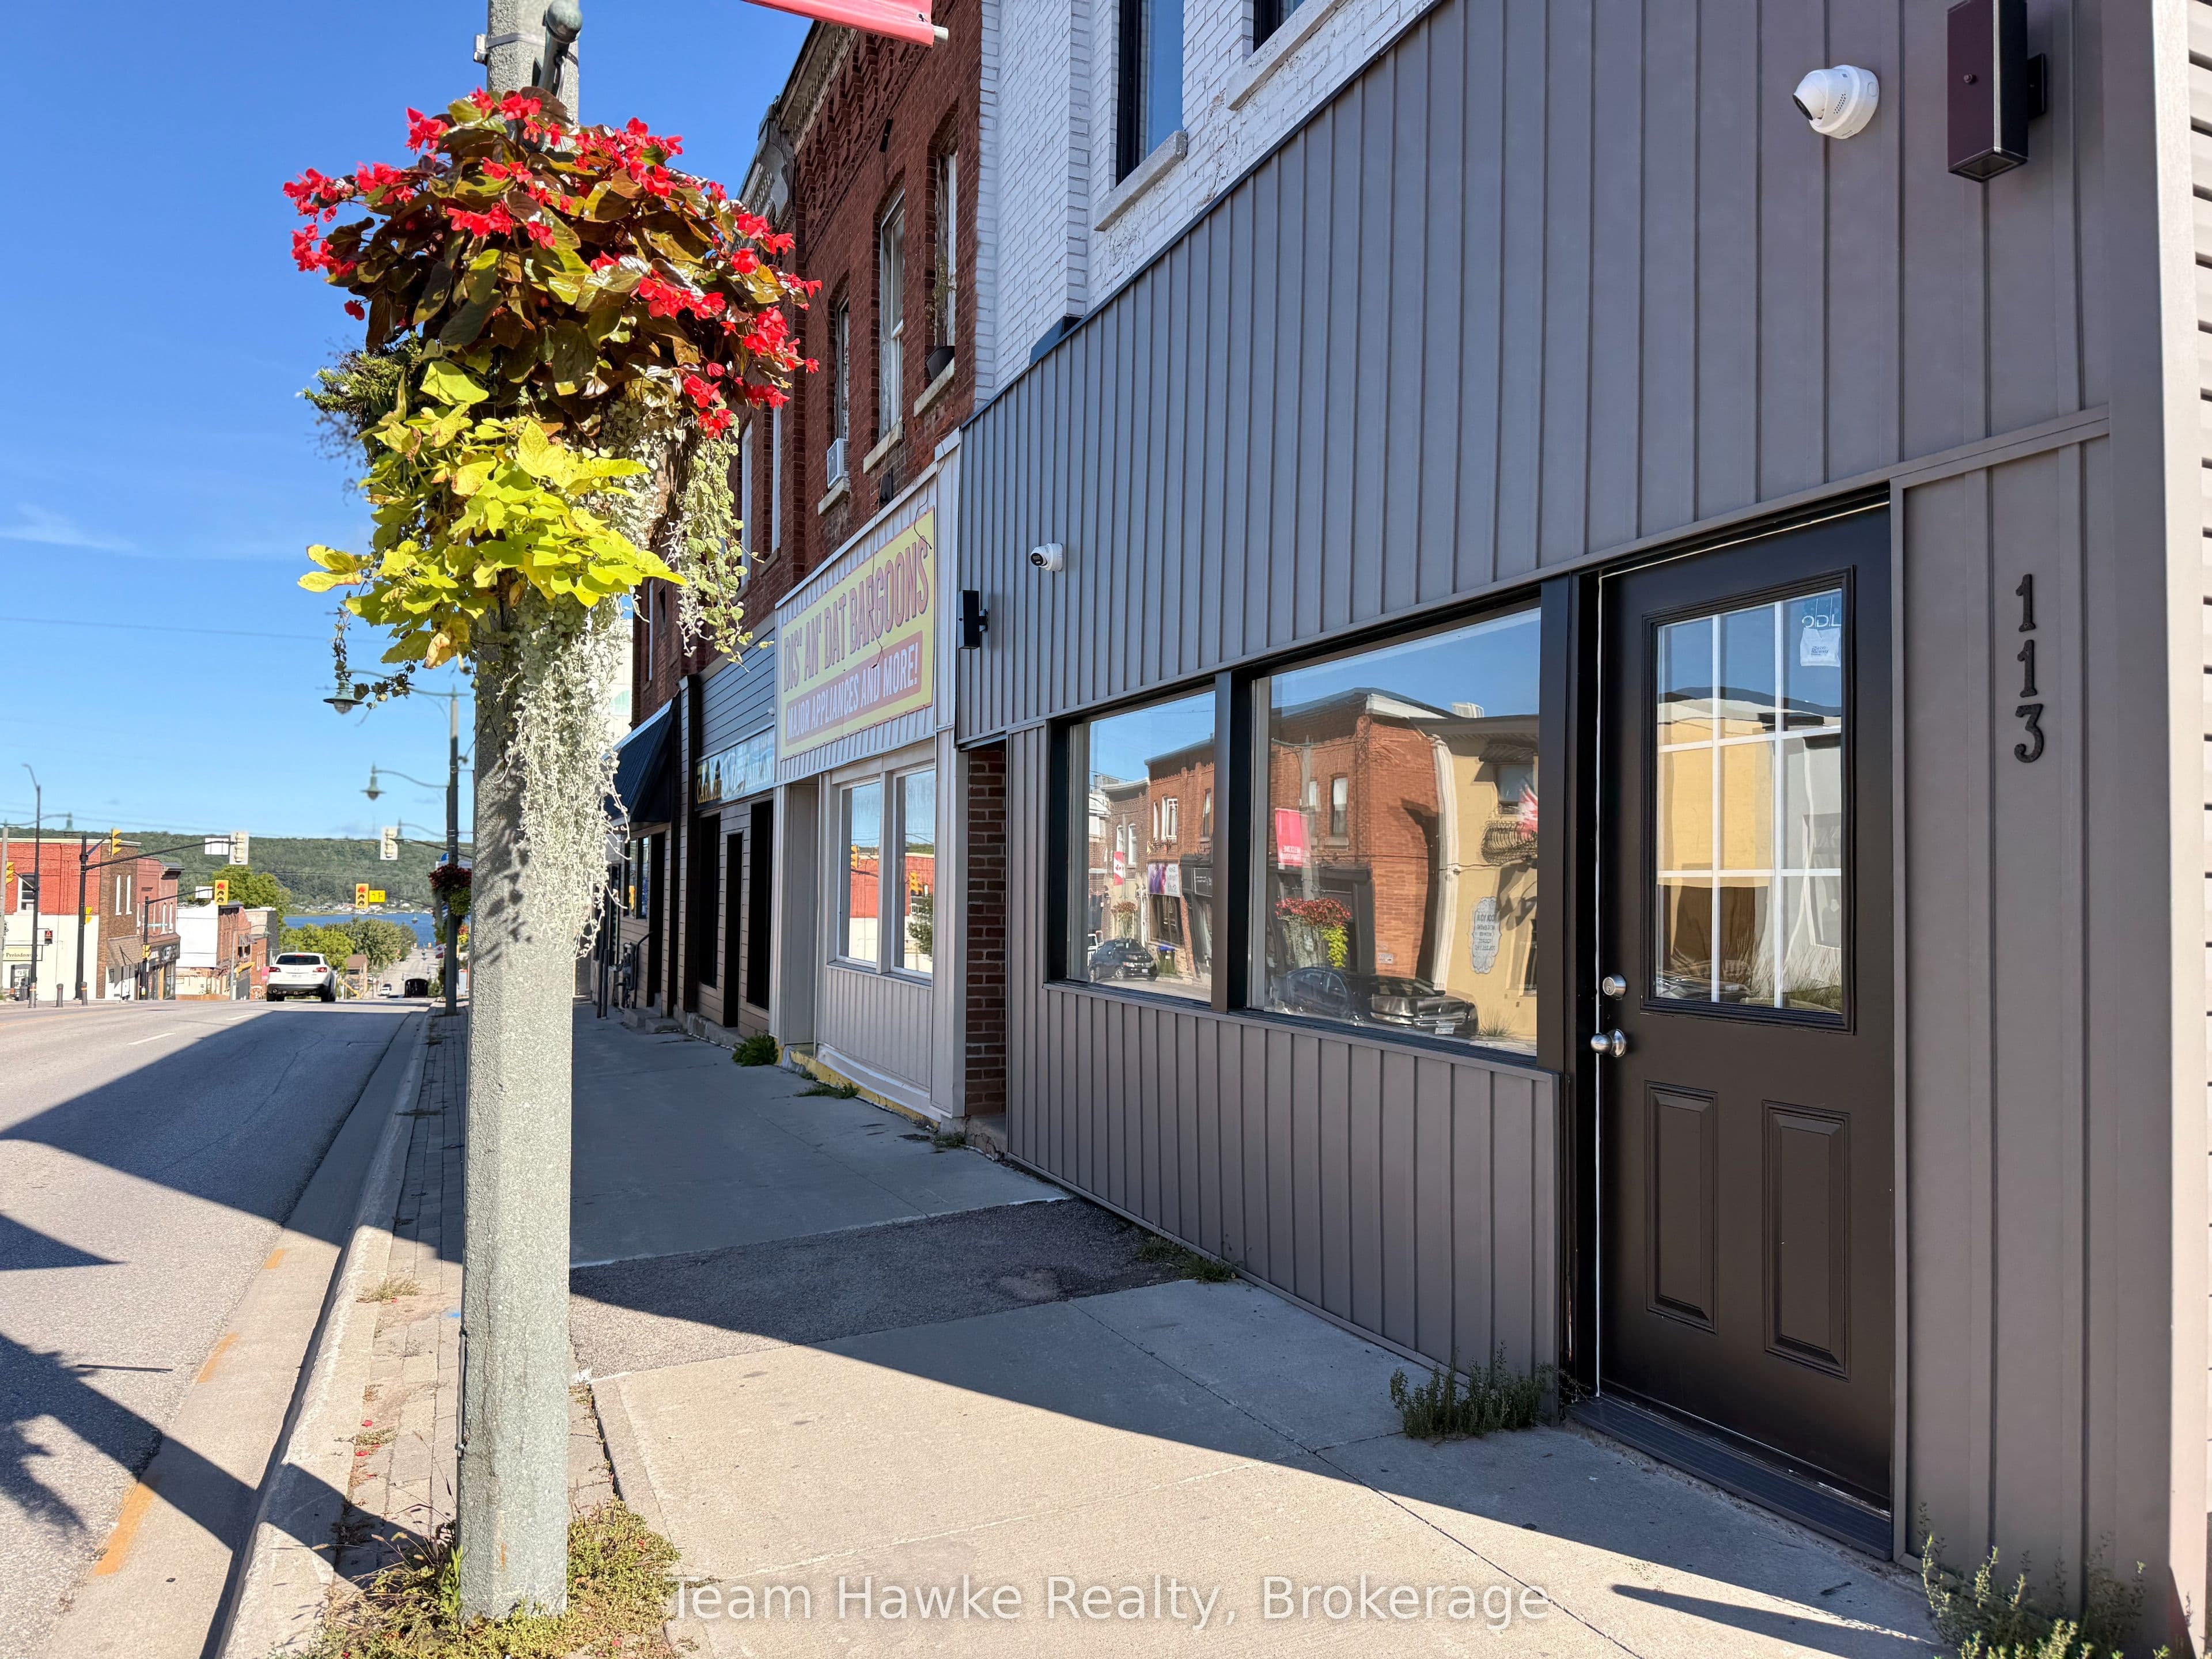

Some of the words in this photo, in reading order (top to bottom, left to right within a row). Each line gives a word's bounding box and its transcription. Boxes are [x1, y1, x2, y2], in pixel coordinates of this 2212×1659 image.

[784, 627, 802, 692] DIS'
[804, 612, 821, 681] AN'
[824, 593, 846, 669] DAT
[850, 535, 929, 654] BARGOONS
[787, 699, 809, 737] MAJOR
[811, 673, 859, 730] APPLIANCES
[861, 664, 880, 708] AND
[884, 642, 919, 698] MORE!
